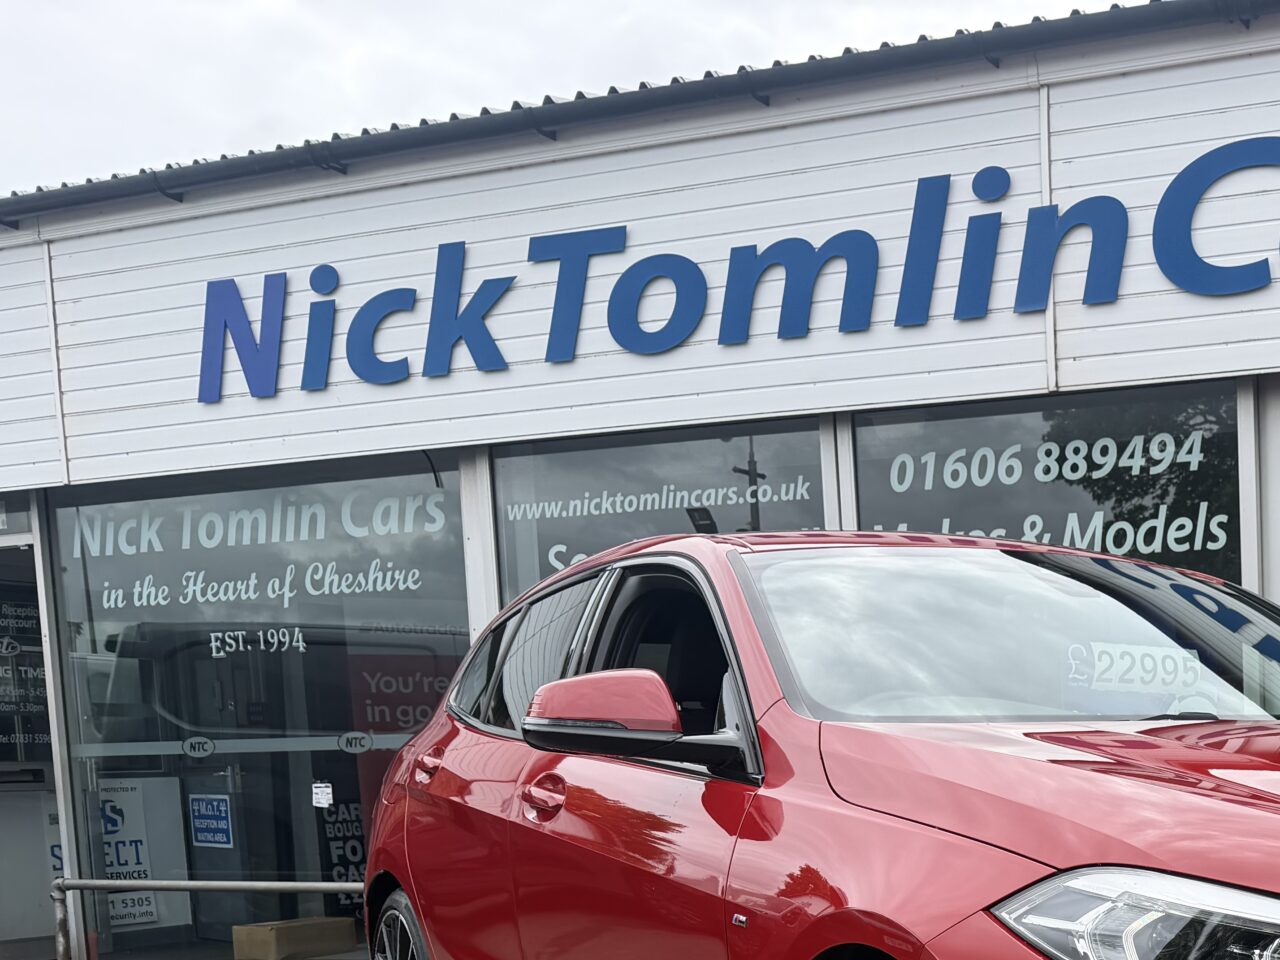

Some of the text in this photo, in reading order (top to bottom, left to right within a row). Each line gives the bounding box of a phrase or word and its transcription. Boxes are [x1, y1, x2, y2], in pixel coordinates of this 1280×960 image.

[889, 430, 1205, 493] 01606 889494
[507, 475, 812, 521] www.nicktomlincars.co.uk
[72, 489, 446, 559] Nick Tomlin Cars
[1062, 501, 1229, 556] Models
[102, 557, 422, 609] in the Heart of Cheshire
[2, 603, 38, 618] Receptio
[0, 618, 37, 628] orecourt
[209, 627, 307, 659] EST. 1994
[18, 666, 45, 678] TIME
[365, 699, 432, 728] in go
[190, 741, 209, 752] NTC
[345, 736, 366, 748] NTC
[323, 803, 362, 823] CAR
[325, 822, 363, 838] BOUG
[329, 839, 363, 864] FO
[122, 897, 152, 909] 5305
[110, 910, 154, 921] ecurity.info
